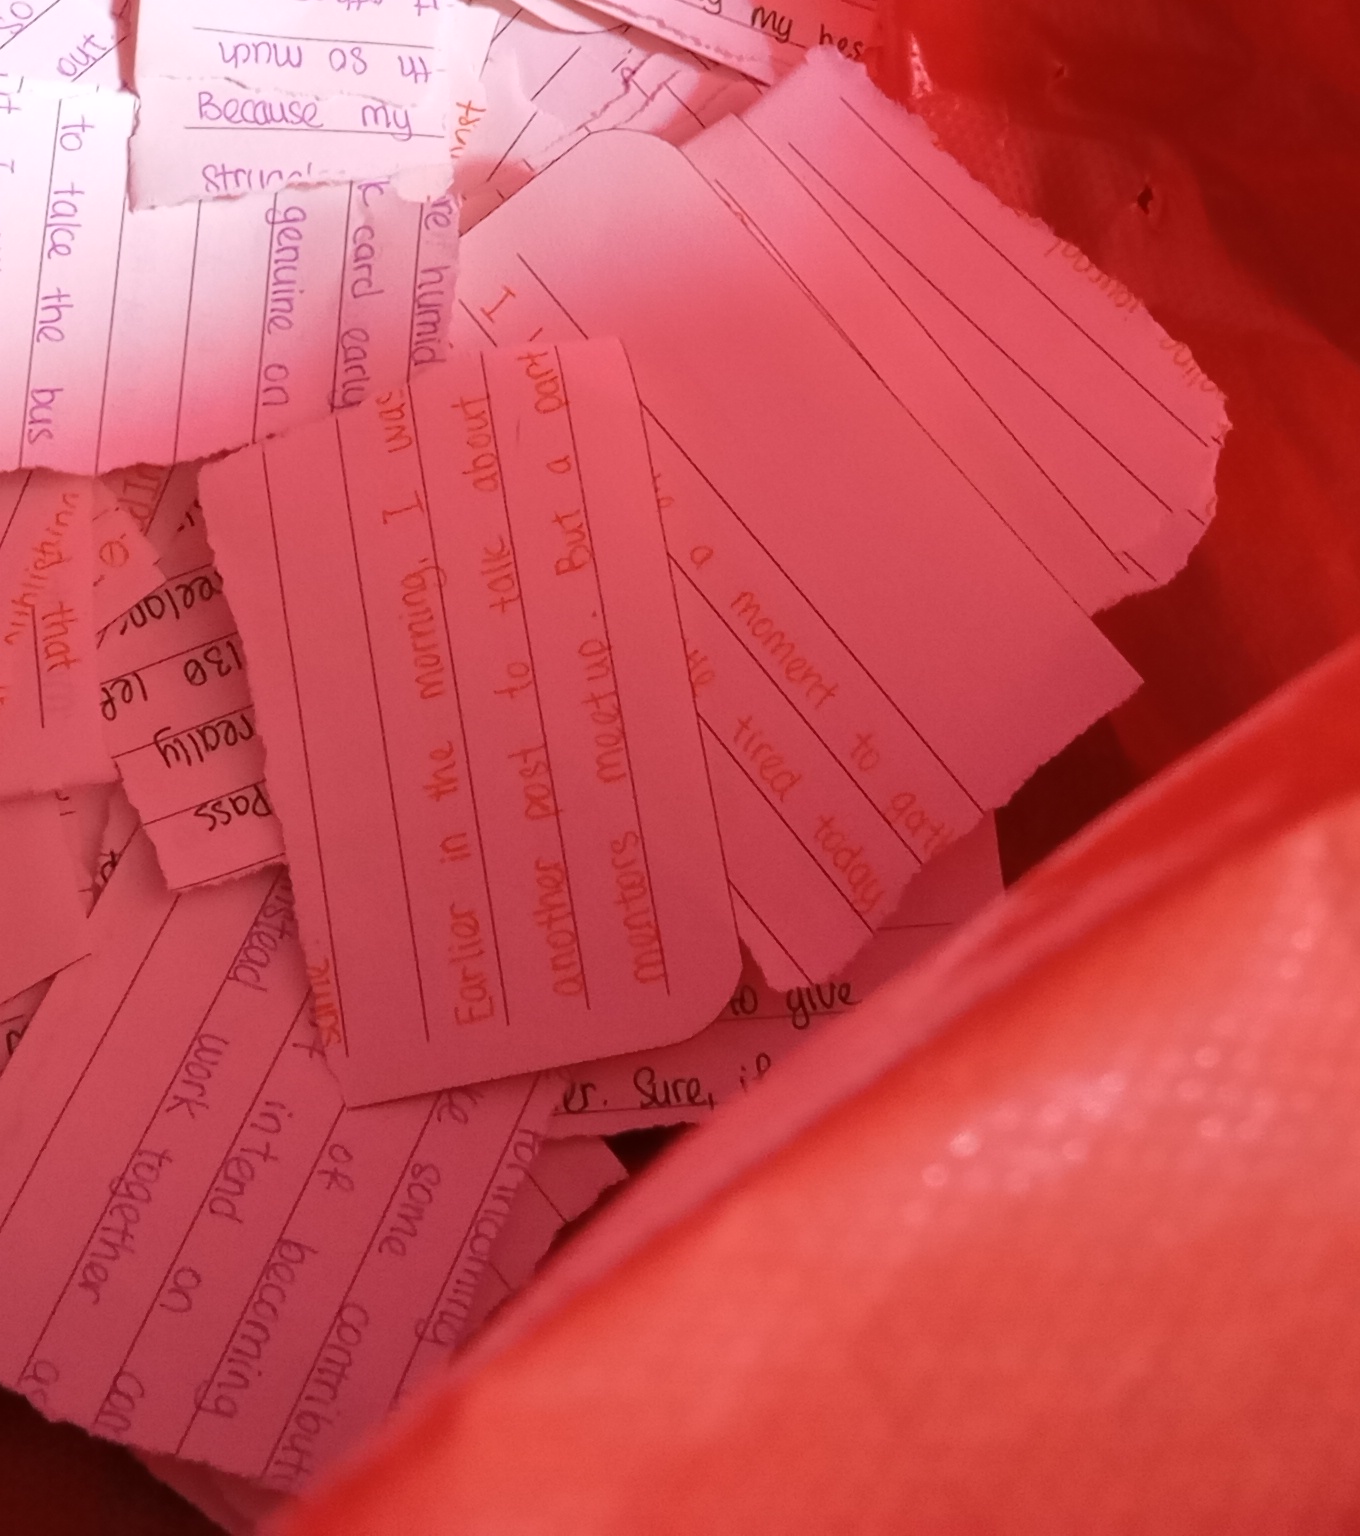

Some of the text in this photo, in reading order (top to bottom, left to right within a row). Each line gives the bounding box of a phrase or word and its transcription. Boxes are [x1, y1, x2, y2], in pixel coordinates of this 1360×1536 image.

[55, 33, 108, 78] out
[217, 39, 303, 71] much
[328, 45, 368, 76] so
[750, 3, 793, 45] my
[197, 89, 325, 130] Because
[361, 103, 413, 142] my
[27, 114, 95, 446] to take the bus
[262, 205, 307, 407] genuine on
[327, 224, 385, 410] card early
[413, 265, 451, 367] humid
[450, 395, 500, 494] about
[546, 454, 574, 475] a
[380, 488, 426, 526] I
[551, 508, 591, 577] But
[479, 534, 523, 615] talk
[41, 599, 82, 674] that
[688, 543, 881, 774] a moment to
[493, 661, 531, 700] to
[152, 713, 256, 769] really
[421, 740, 460, 803] the
[439, 831, 473, 865] in
[731, 713, 886, 915] tired today
[448, 901, 495, 1027] Earlier
[532, 855, 586, 998] another
[785, 979, 857, 1031] give
[78, 1032, 231, 1307] work together
[317, 1142, 356, 1194] of
[159, 1099, 295, 1314] intend on
[378, 1162, 442, 1258] some
[193, 1236, 320, 1420] becoming
